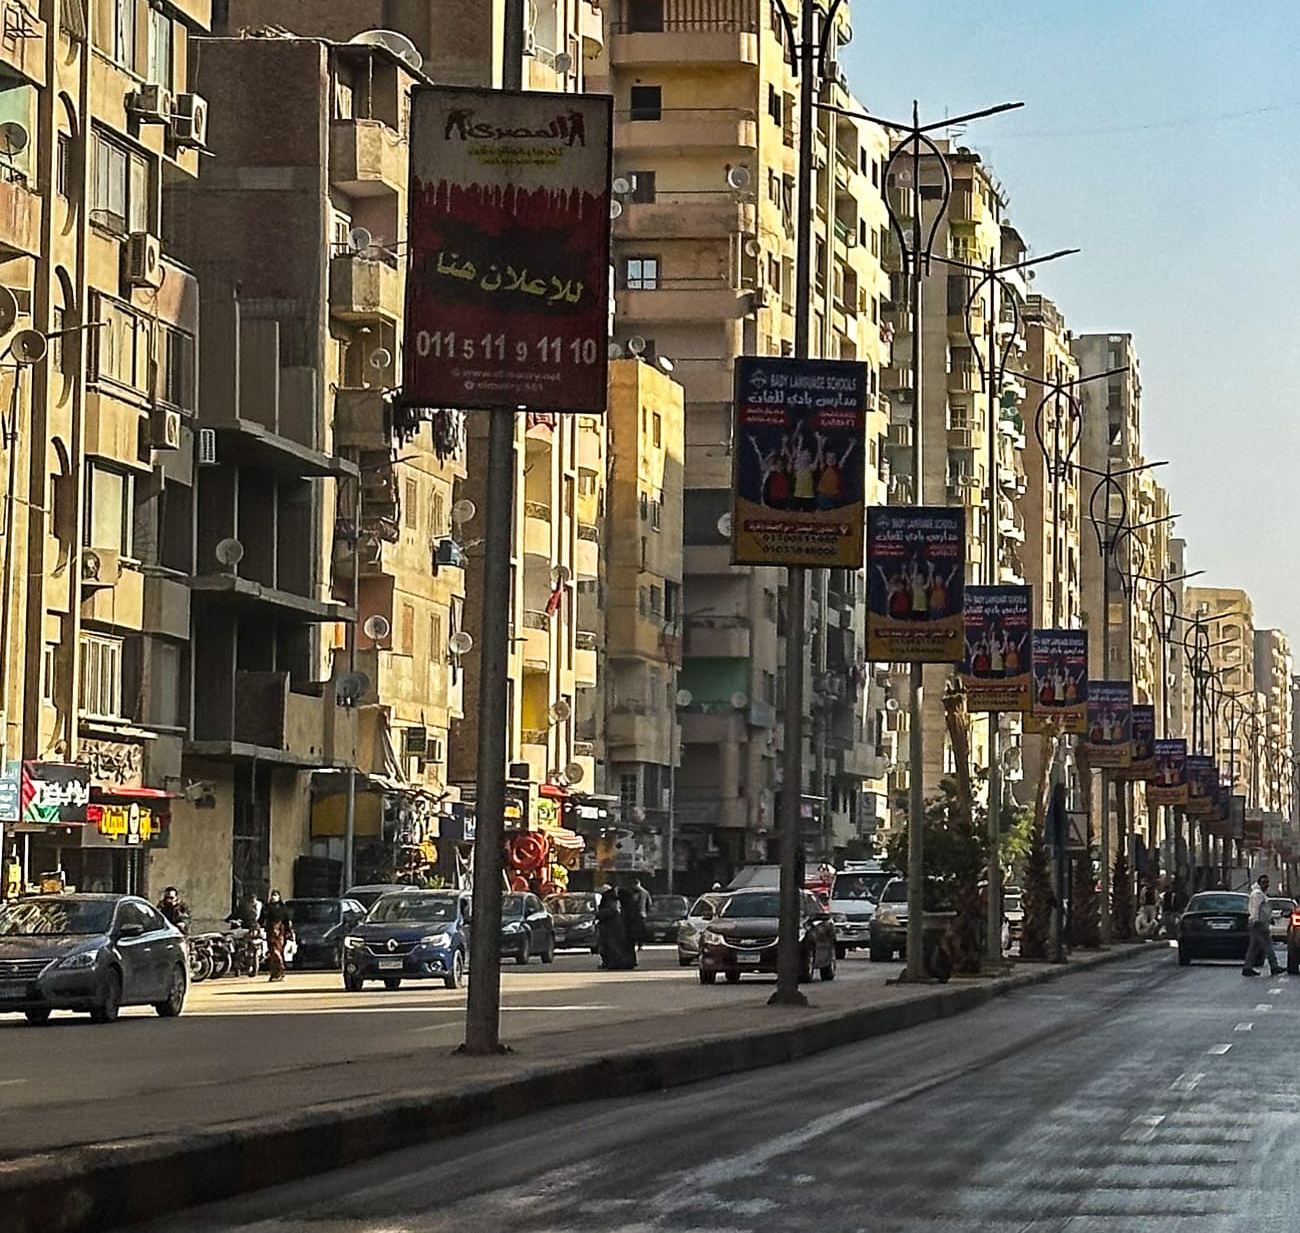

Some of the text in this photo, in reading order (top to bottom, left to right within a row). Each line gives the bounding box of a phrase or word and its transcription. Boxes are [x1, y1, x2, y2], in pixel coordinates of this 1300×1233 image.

[436, 251, 585, 306] للإعلان هنا
[416, 330, 597, 364] 011 5 11 9 11 10
[815, 392, 857, 407] مدارس
